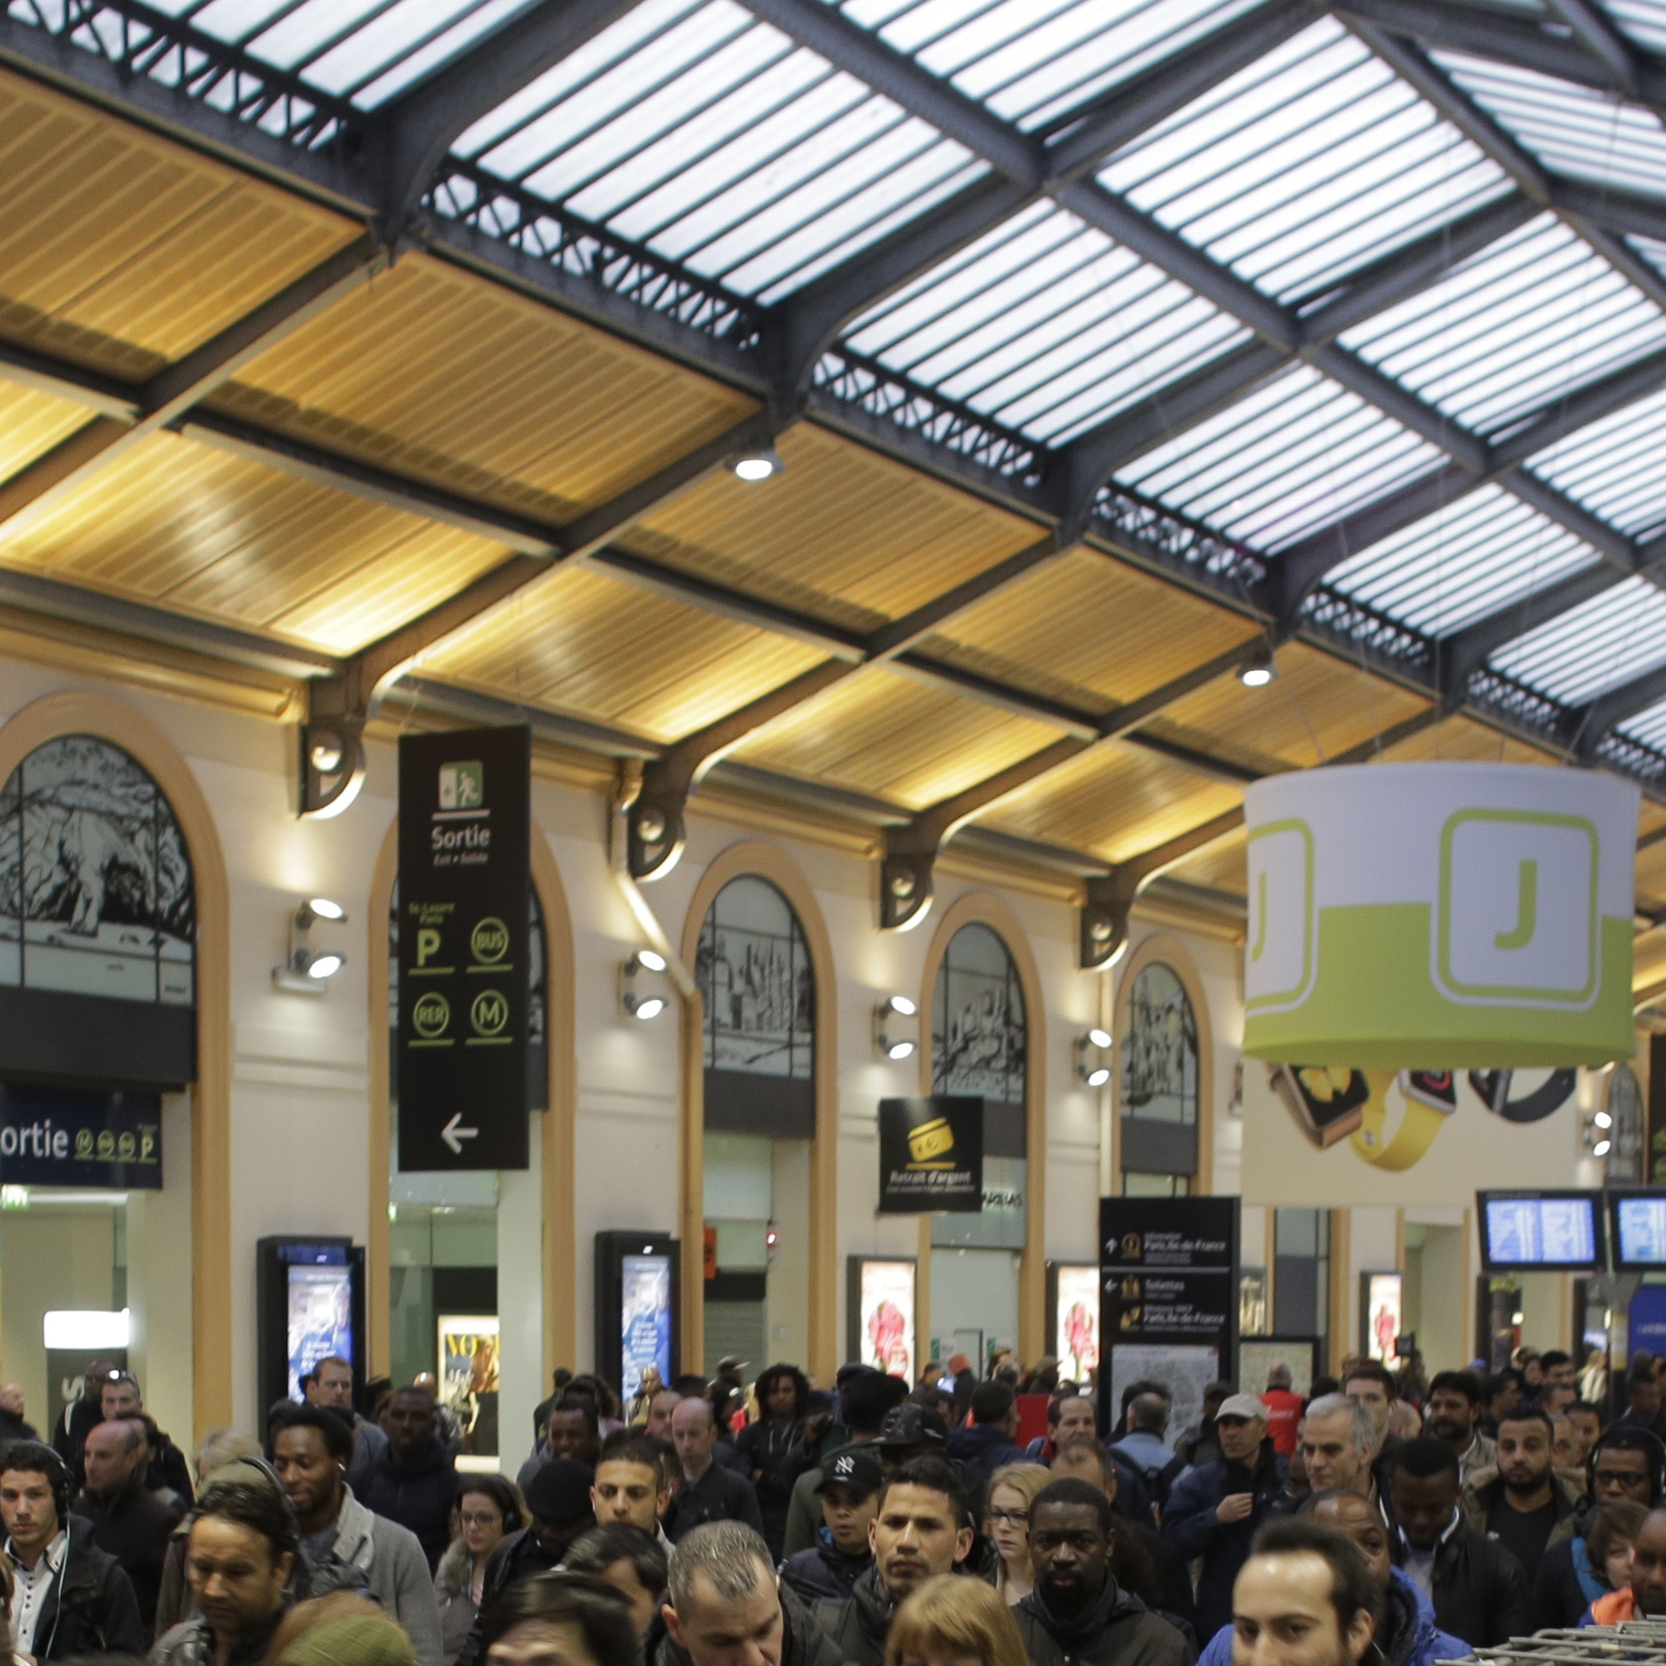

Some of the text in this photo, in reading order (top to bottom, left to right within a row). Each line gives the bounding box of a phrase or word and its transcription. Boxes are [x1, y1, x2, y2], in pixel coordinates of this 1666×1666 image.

[432, 824, 491, 851] Sortie
[1494, 859, 1538, 950] J
[417, 918, 504, 968] P BUS
[418, 1000, 500, 1026] RER M
